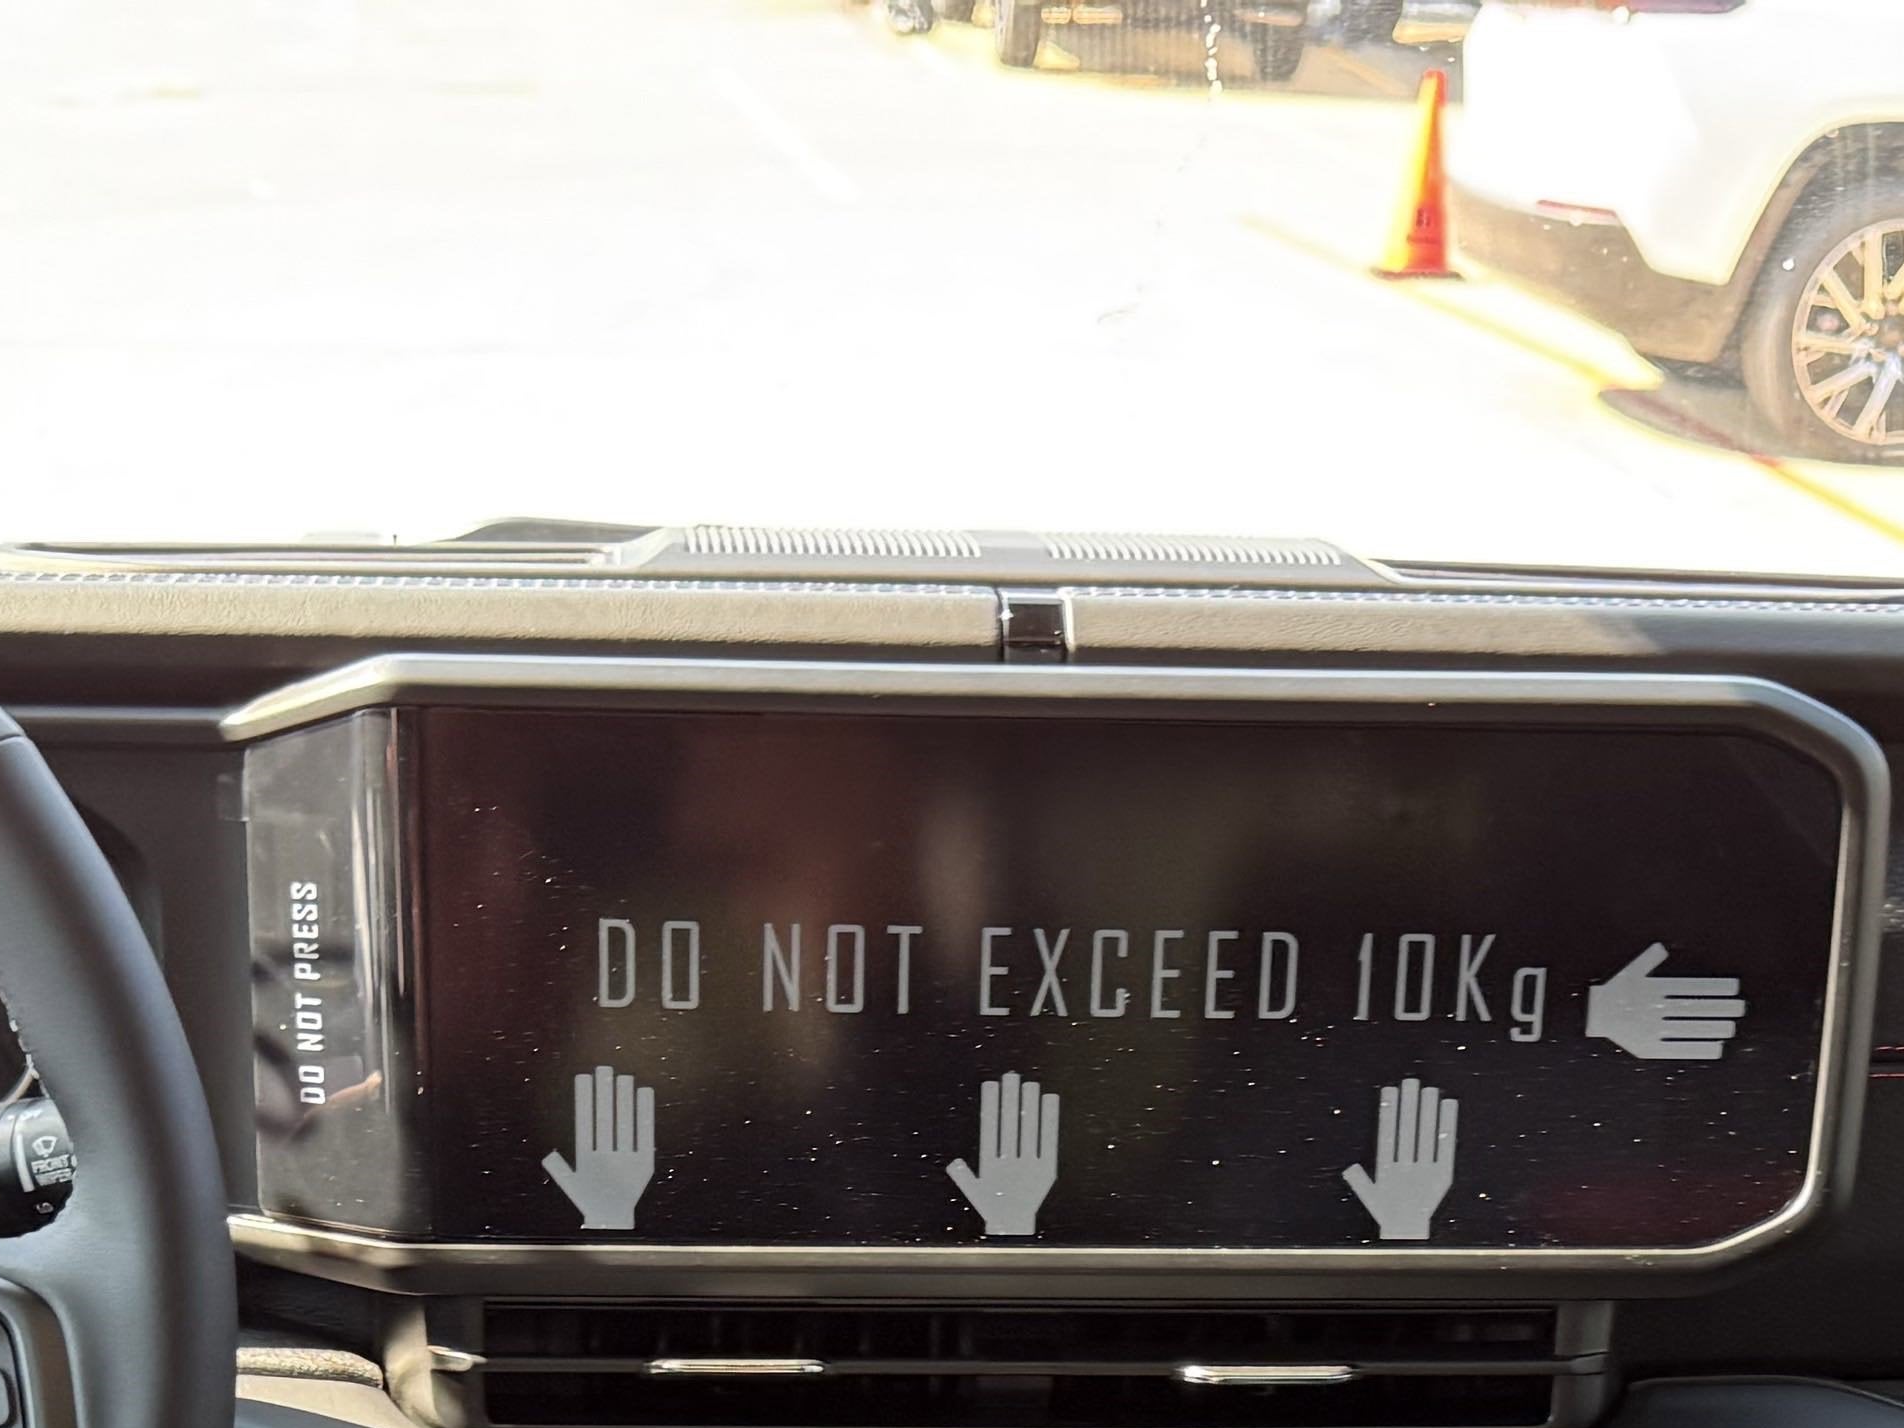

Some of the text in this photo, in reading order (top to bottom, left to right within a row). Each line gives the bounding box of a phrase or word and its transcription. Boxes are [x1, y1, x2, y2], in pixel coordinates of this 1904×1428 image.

[290, 881, 326, 1104] DO NOT PRESS
[599, 918, 1548, 1042] DO NOT EXCEED 10Kg
